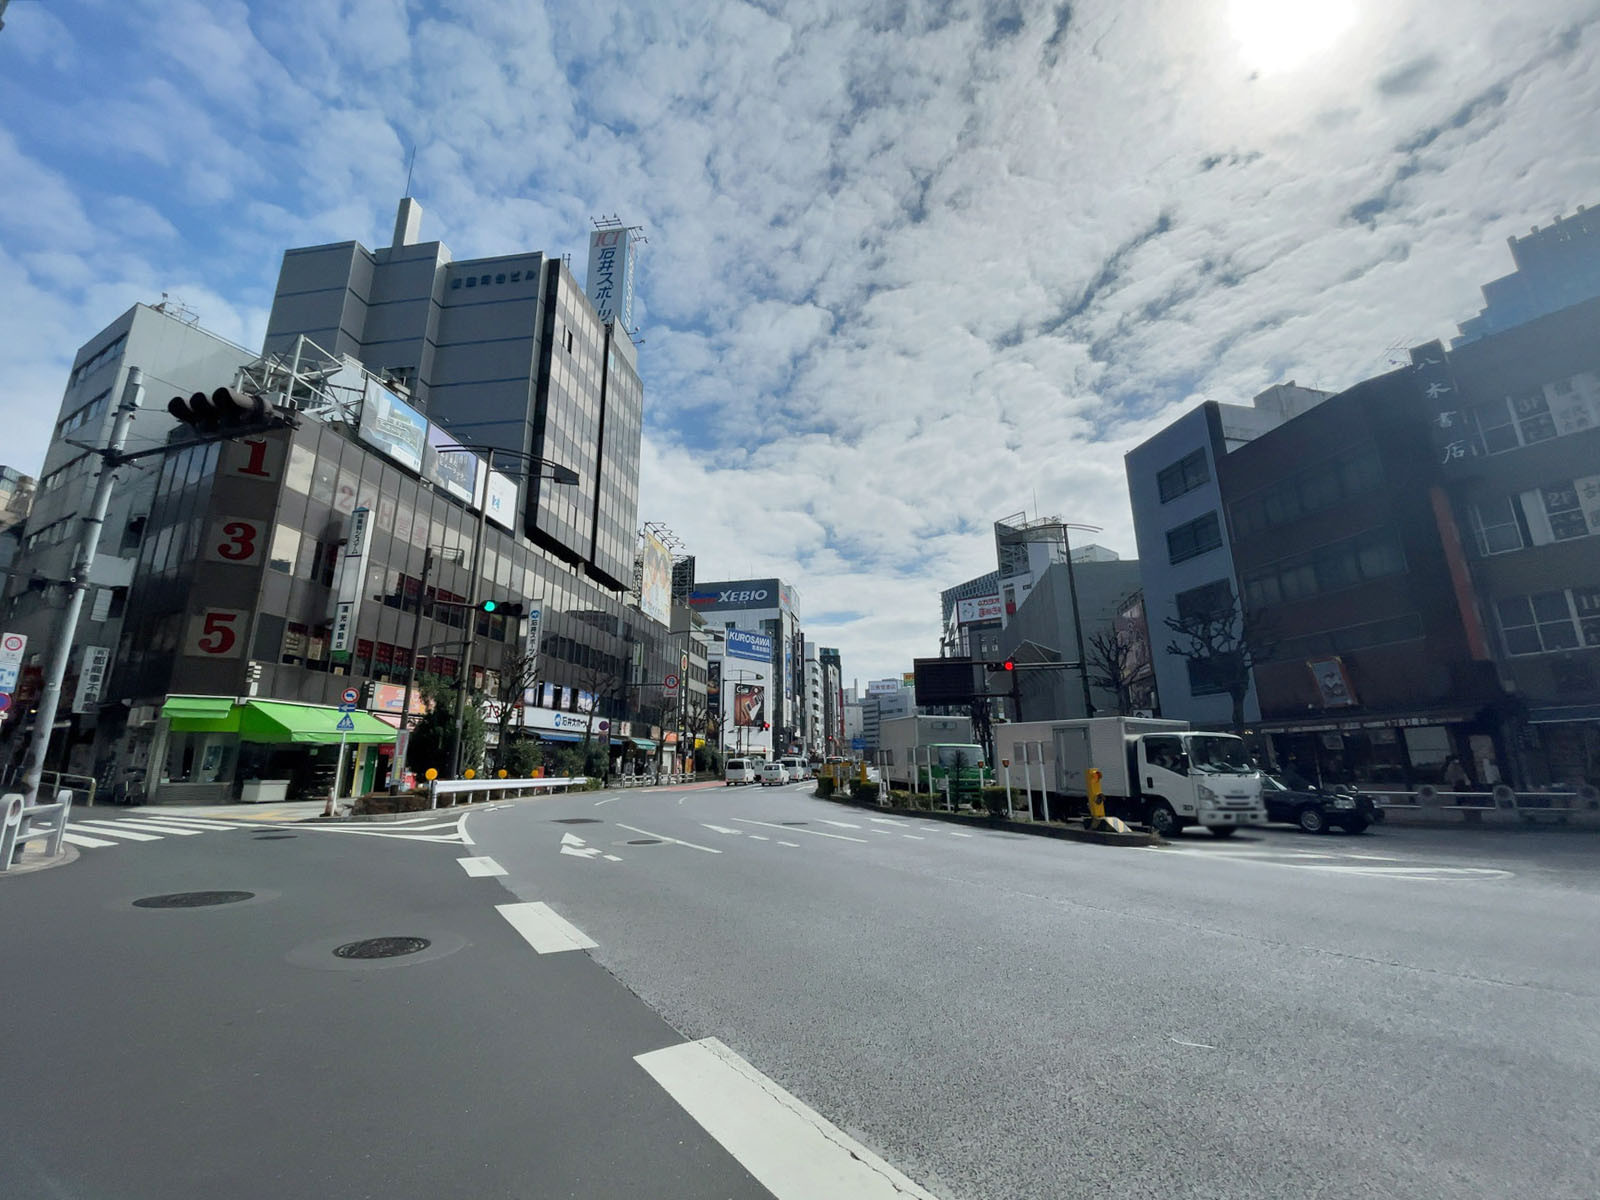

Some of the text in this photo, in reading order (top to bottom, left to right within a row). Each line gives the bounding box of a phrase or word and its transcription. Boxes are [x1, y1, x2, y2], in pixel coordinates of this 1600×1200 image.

[595, 247, 617, 321] 石井スポーツ
[237, 440, 270, 477] 1
[217, 522, 257, 561] 3
[718, 590, 768, 602] XEBIO
[198, 611, 237, 653] 5
[728, 631, 770, 647] KUROSAWA
